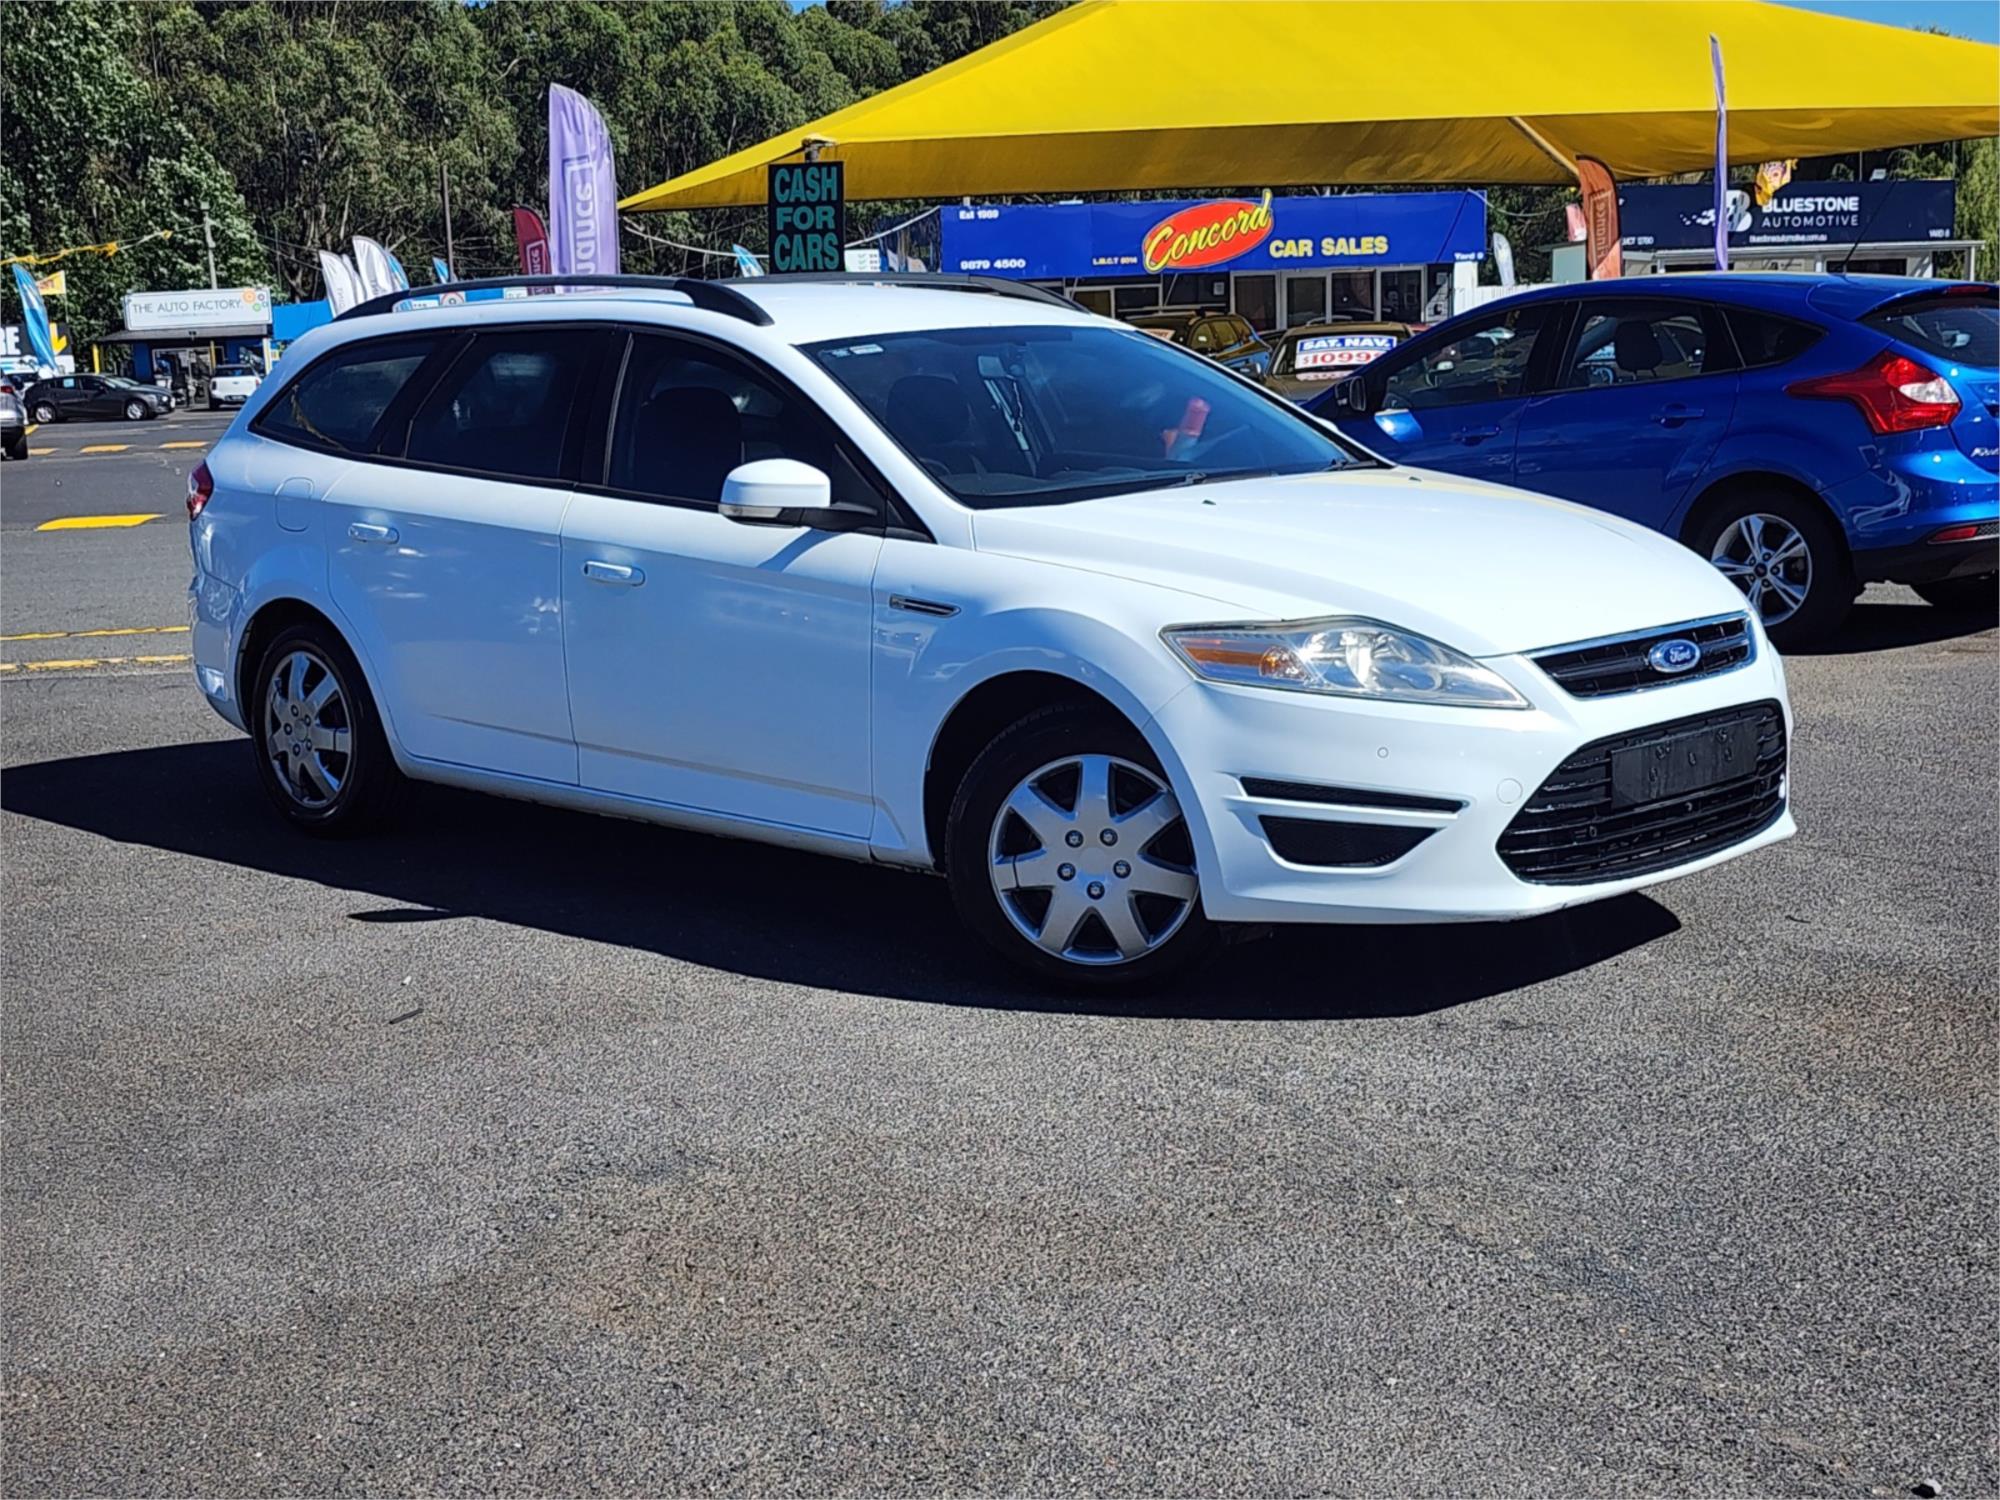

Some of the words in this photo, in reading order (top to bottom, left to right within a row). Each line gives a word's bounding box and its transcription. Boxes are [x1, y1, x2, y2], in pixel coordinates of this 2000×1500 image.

[774, 166, 838, 203] CASH
[1761, 196, 1860, 213] BLUESTONE
[775, 205, 836, 231] FOR
[959, 209, 975, 220] Est
[1761, 214, 1860, 229] AUTOMOTIVE
[1145, 191, 1271, 270] Concord
[774, 231, 840, 272] CARS
[1269, 239, 1314, 258] CAR
[1320, 236, 1390, 257] SALES
[960, 259, 991, 271] 9879
[993, 258, 1027, 270] 4500
[133, 303, 153, 314] THE
[157, 301, 189, 313] AUTO
[1344, 337, 1391, 348] NAV.
[1669, 646, 1691, 663] Ford
